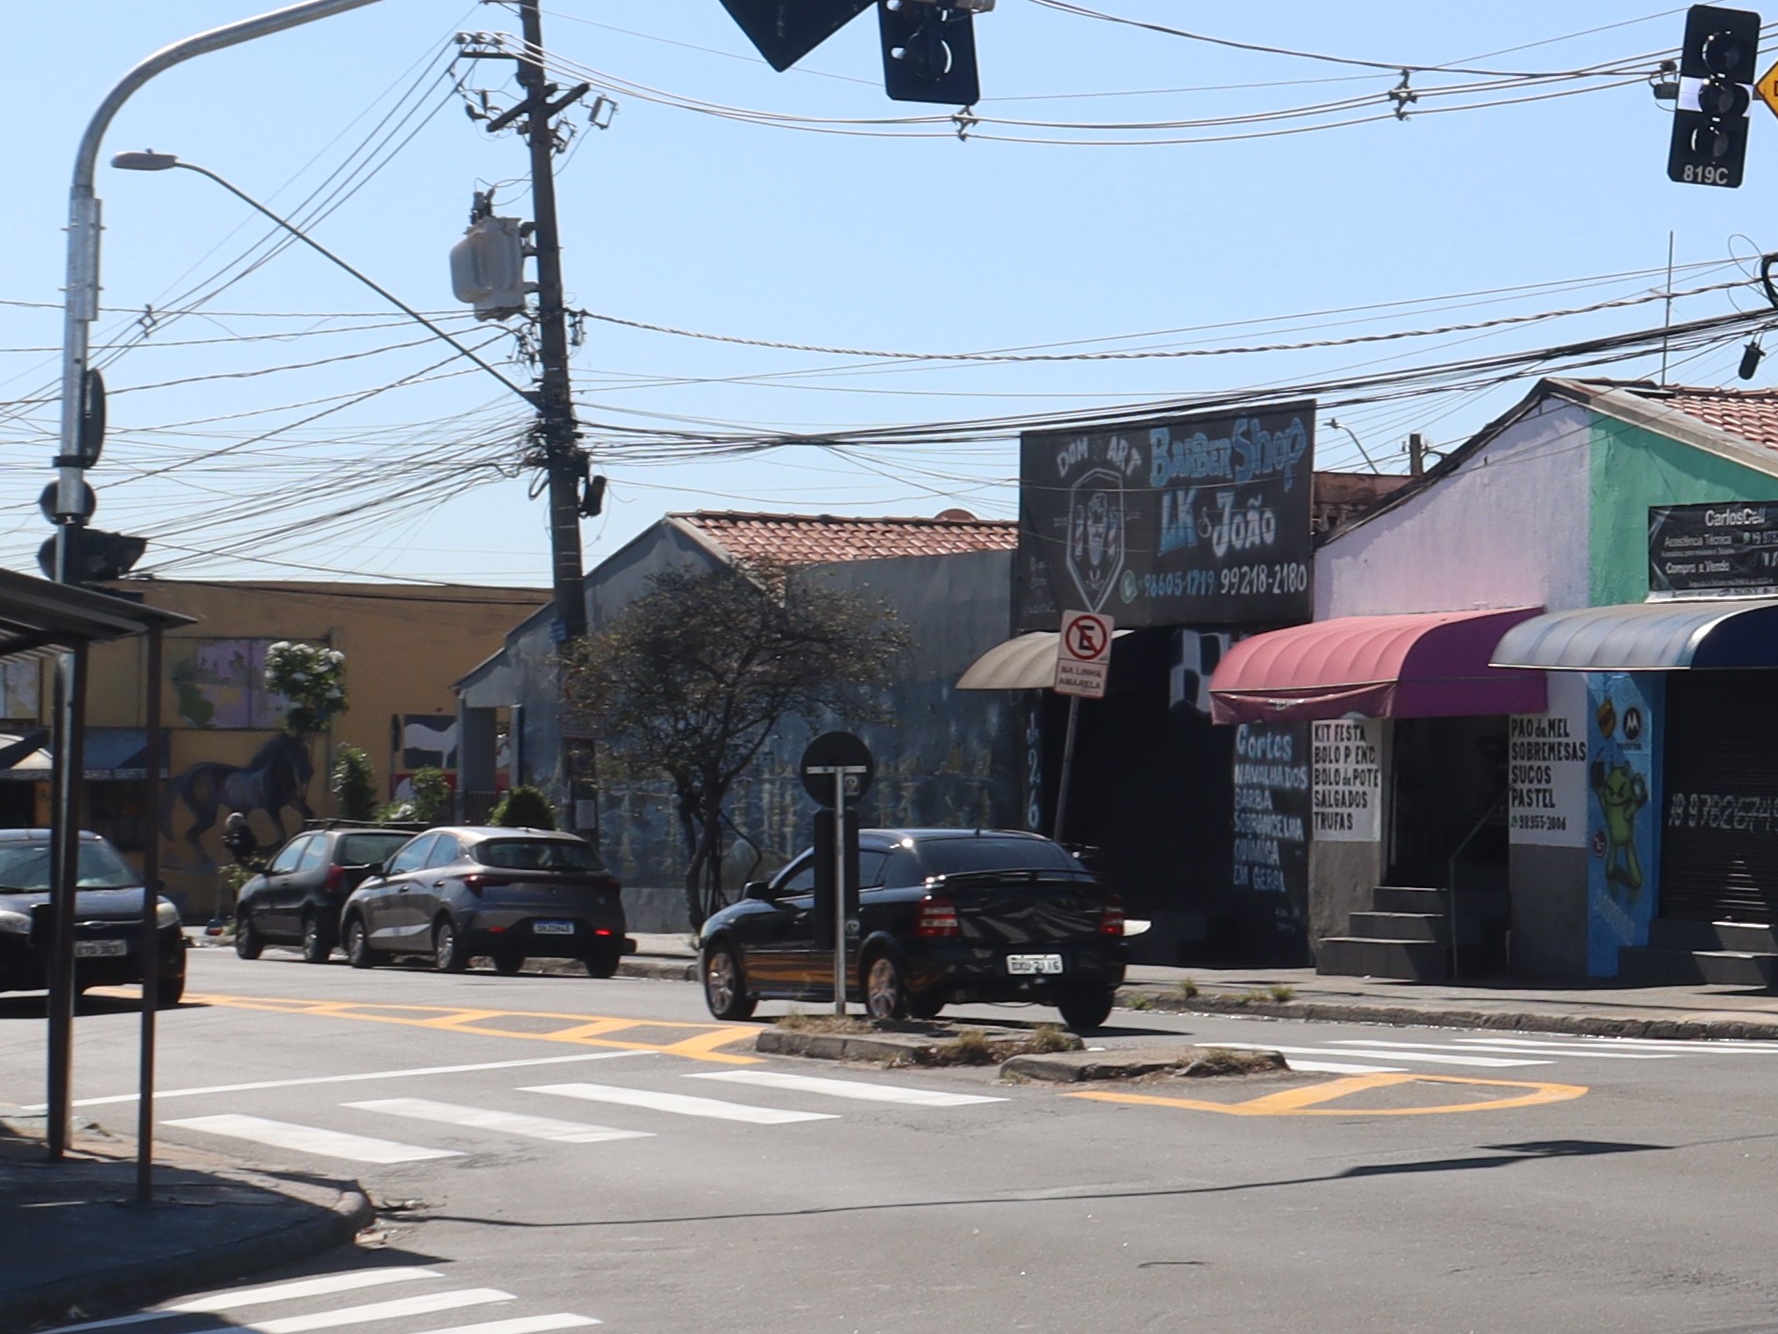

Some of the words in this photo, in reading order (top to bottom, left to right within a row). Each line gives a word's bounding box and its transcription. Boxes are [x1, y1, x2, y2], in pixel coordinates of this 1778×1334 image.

[1683, 164, 1729, 185] 819C
[1106, 436, 1143, 476] ART
[1219, 563, 1307, 595] 99218-2180
[1076, 667, 1102, 678] LINHA
[1059, 678, 1102, 689] AMARELA
[1314, 724, 1331, 742] KIT
[1334, 724, 1367, 742] FESTA
[1548, 718, 1570, 737] MEL
[1236, 723, 1294, 761] Cortes
[1511, 742, 1587, 761] SOBREMESAS
[1314, 746, 1341, 764] BOLO
[1234, 763, 1309, 790] NAVALHADOS
[1314, 768, 1341, 786] BOLO
[1353, 769, 1380, 787] POTE
[1511, 765, 1552, 784] SUCOS
[1234, 788, 1272, 810] BARBA
[1314, 790, 1368, 809] SALGADOS
[1511, 788, 1556, 808] PASTEL
[1314, 812, 1354, 831] TRUFAS
[1233, 865, 1249, 886] EM
